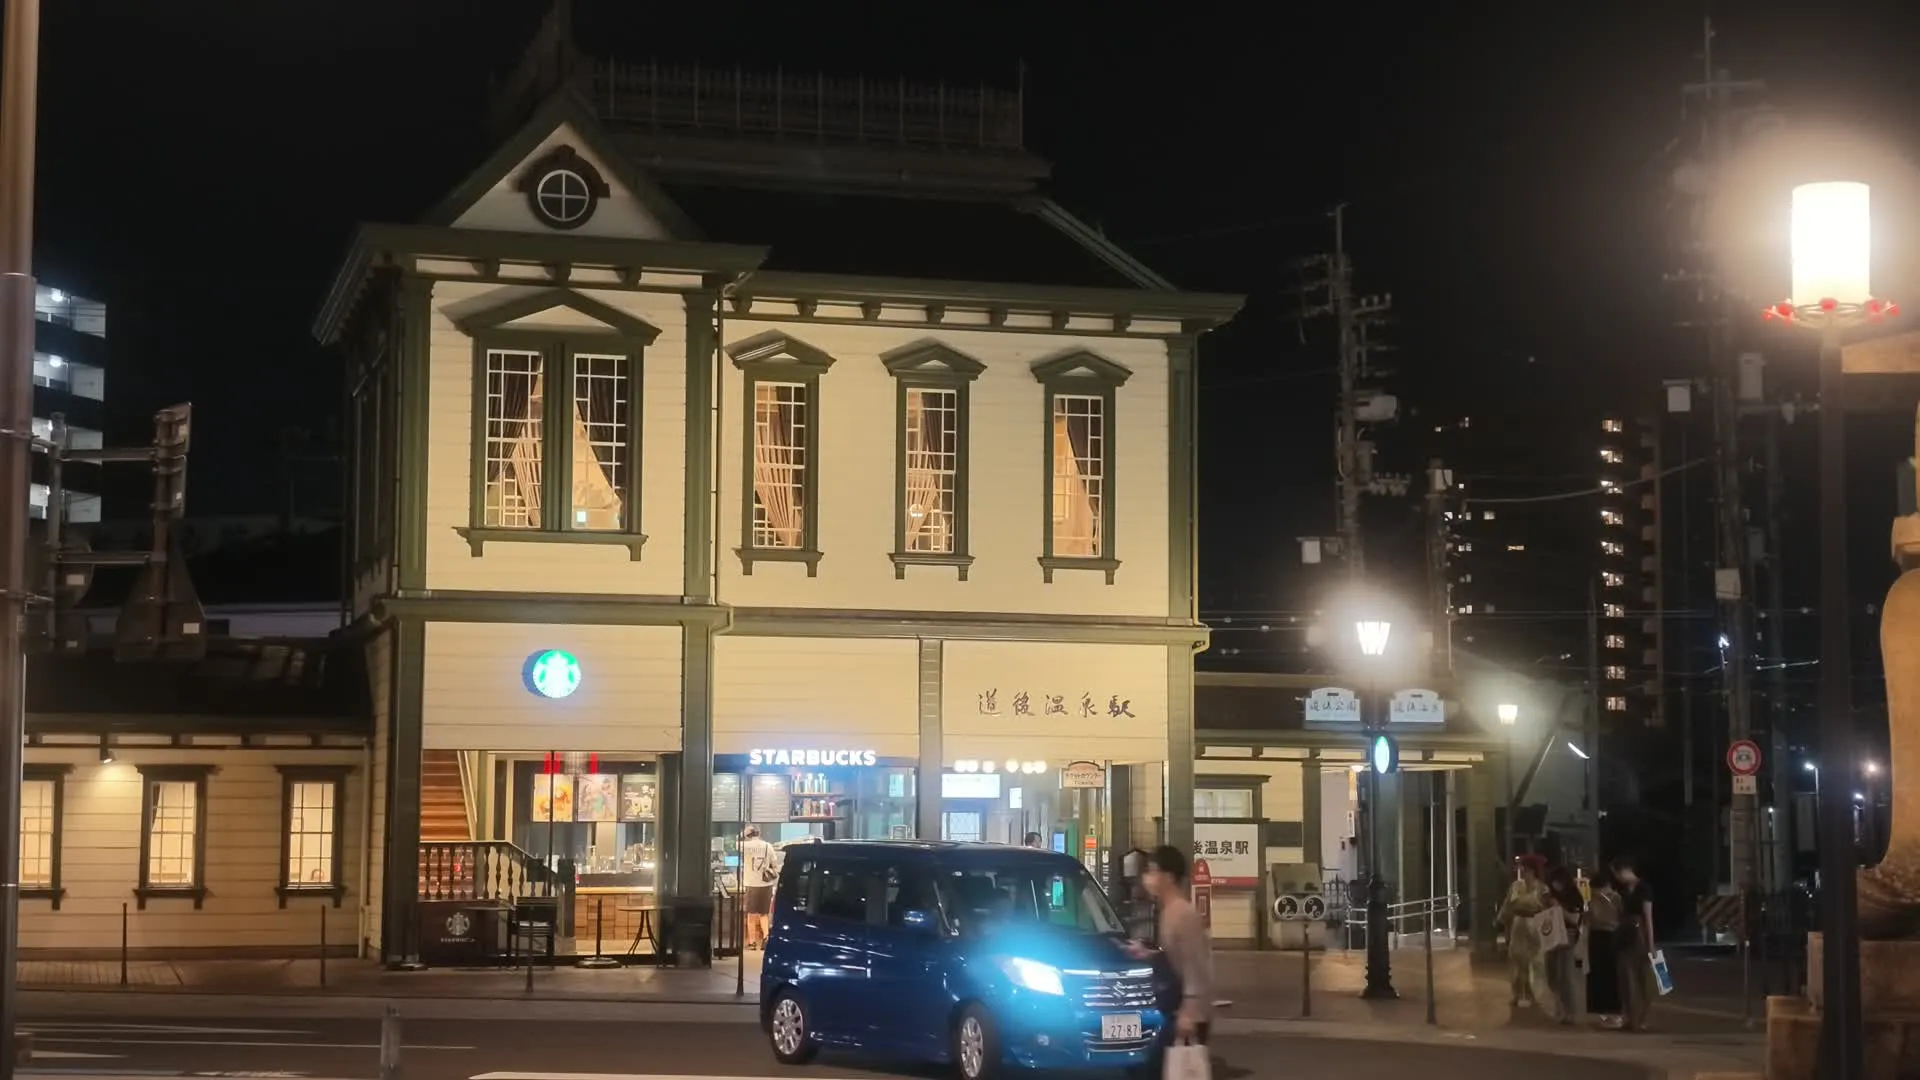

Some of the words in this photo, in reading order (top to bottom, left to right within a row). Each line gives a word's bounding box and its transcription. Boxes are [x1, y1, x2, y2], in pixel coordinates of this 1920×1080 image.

[979, 688, 1136, 718] 道後温泉駅
[749, 748, 877, 766] STARBUCKS
